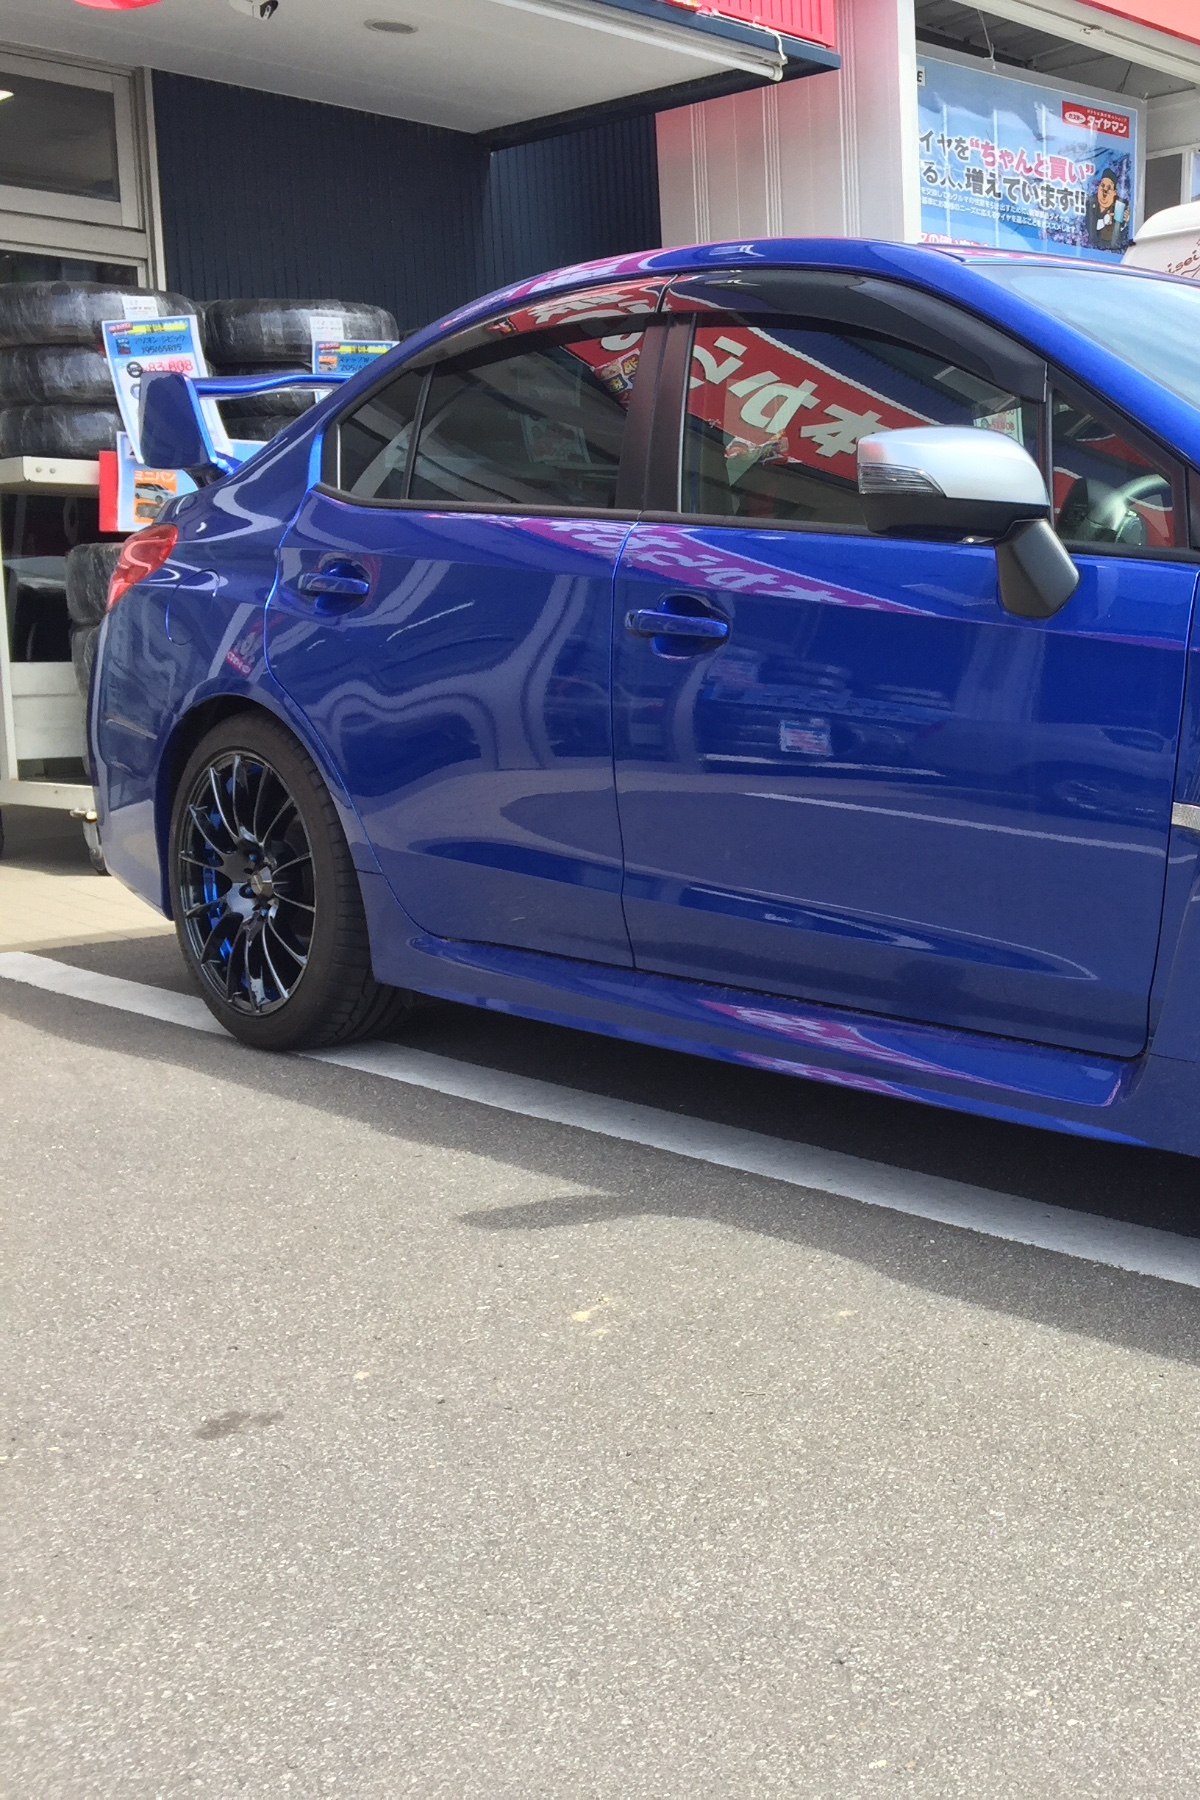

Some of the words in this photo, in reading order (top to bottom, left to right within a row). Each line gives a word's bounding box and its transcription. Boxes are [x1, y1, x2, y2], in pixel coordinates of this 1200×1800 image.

[1087, 115, 1127, 134] タイヤマン
